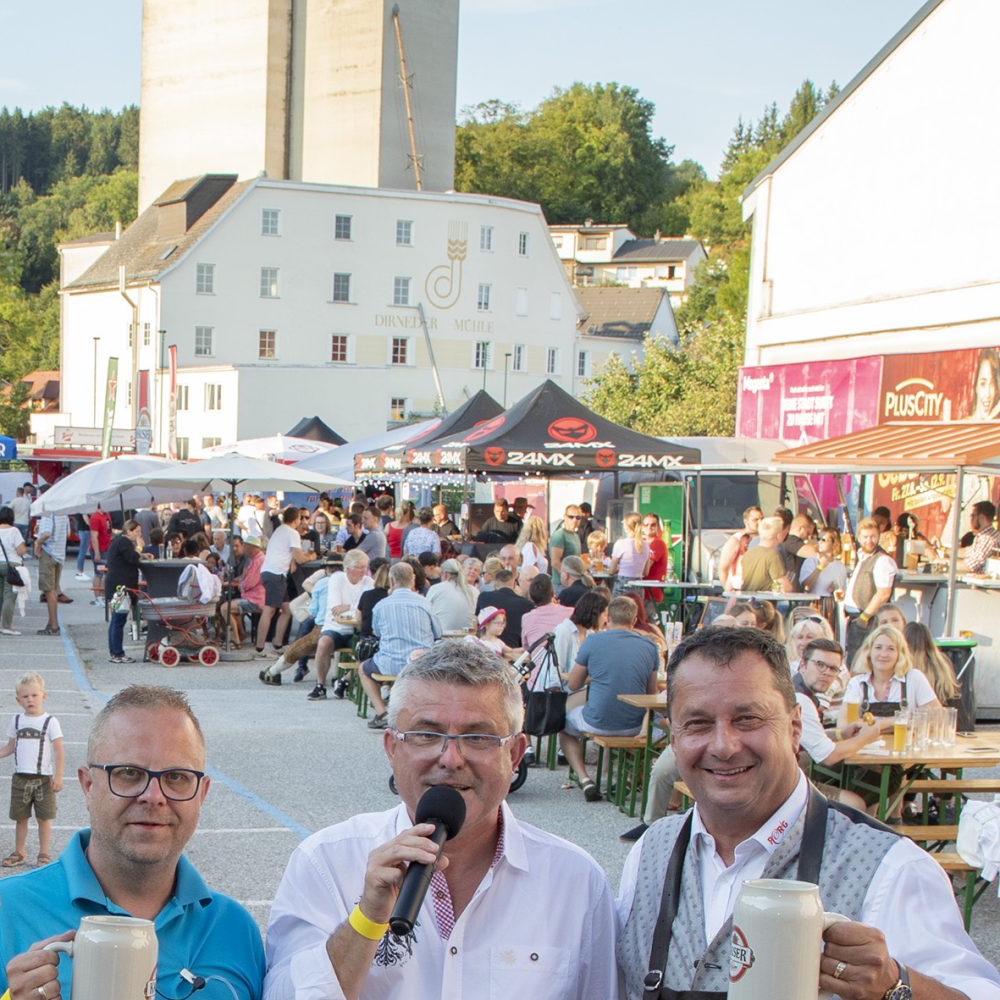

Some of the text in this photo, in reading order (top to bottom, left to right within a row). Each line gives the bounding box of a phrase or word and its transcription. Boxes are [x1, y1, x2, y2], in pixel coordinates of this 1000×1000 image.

[374, 314, 494, 334] DIRNEDER MÜHLE
[440, 452, 461, 465] 24MX
[507, 452, 575, 467] 24MX
[617, 454, 684, 469] 24MX
